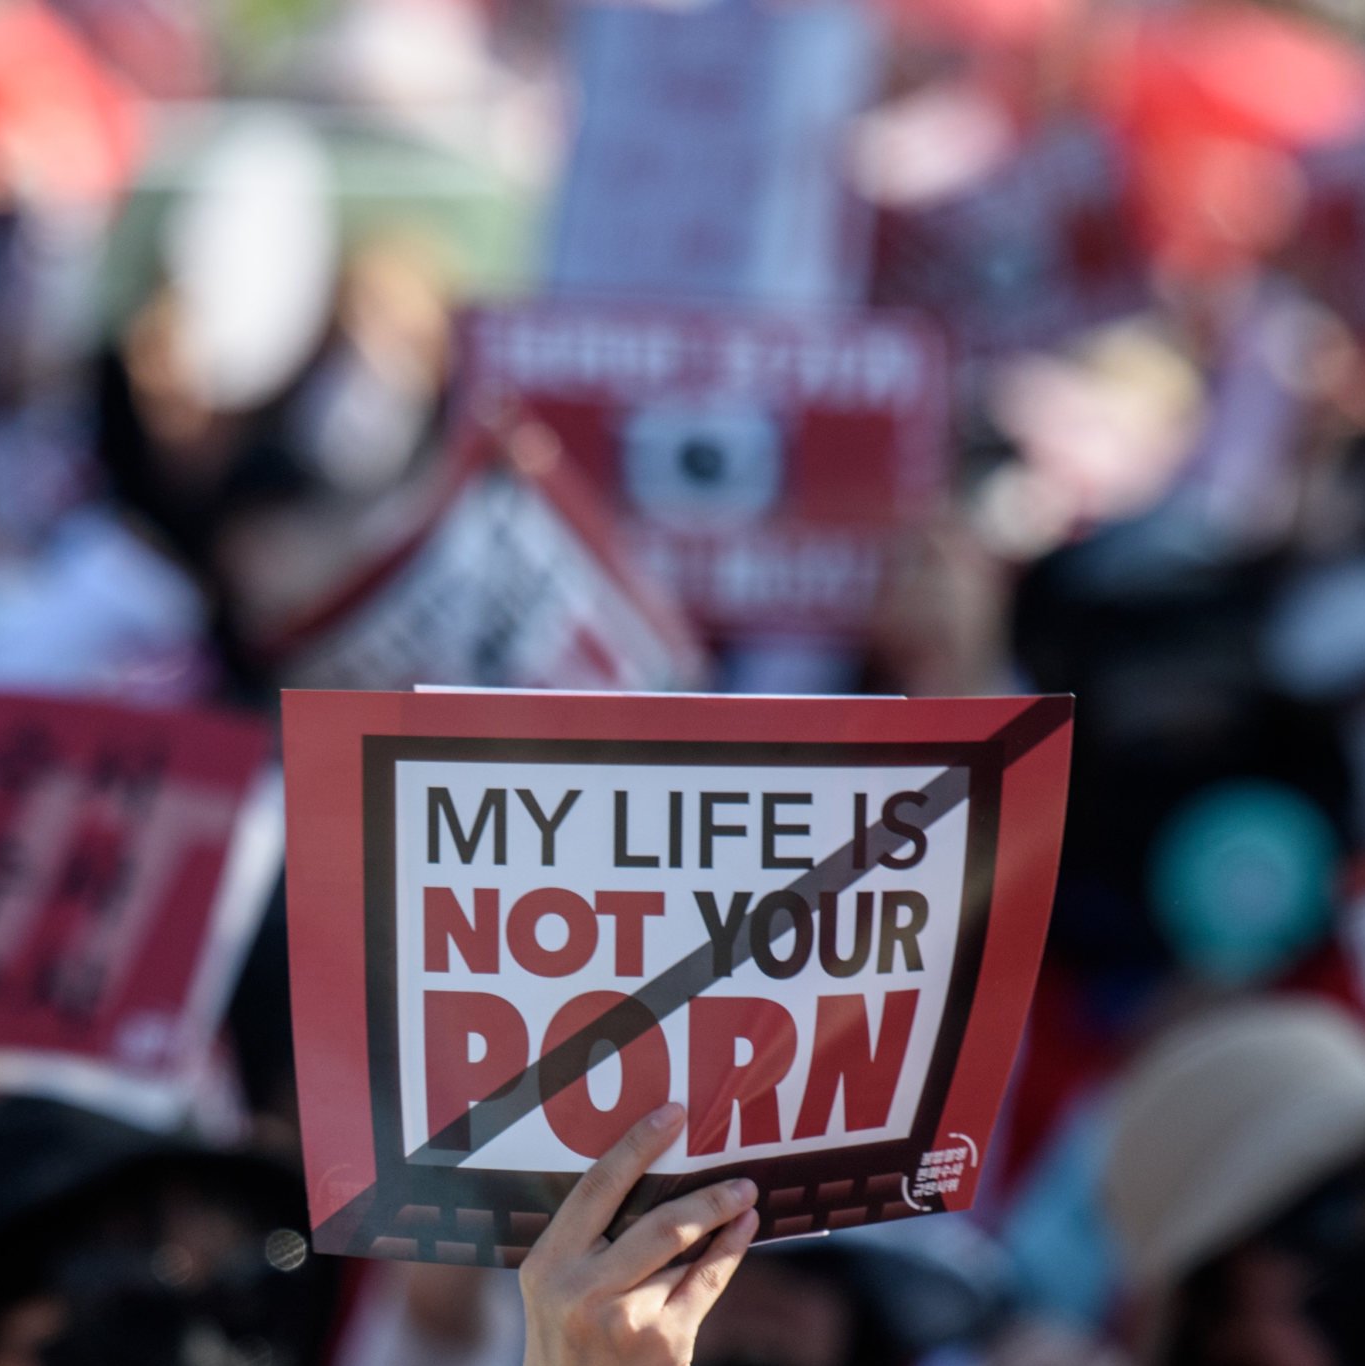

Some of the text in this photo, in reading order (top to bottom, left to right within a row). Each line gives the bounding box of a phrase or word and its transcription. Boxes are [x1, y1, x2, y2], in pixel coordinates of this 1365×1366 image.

[426, 786, 929, 869] MY LIFE IS
[423, 885, 929, 979] NOT YOUR
[423, 989, 921, 1161] PORN
